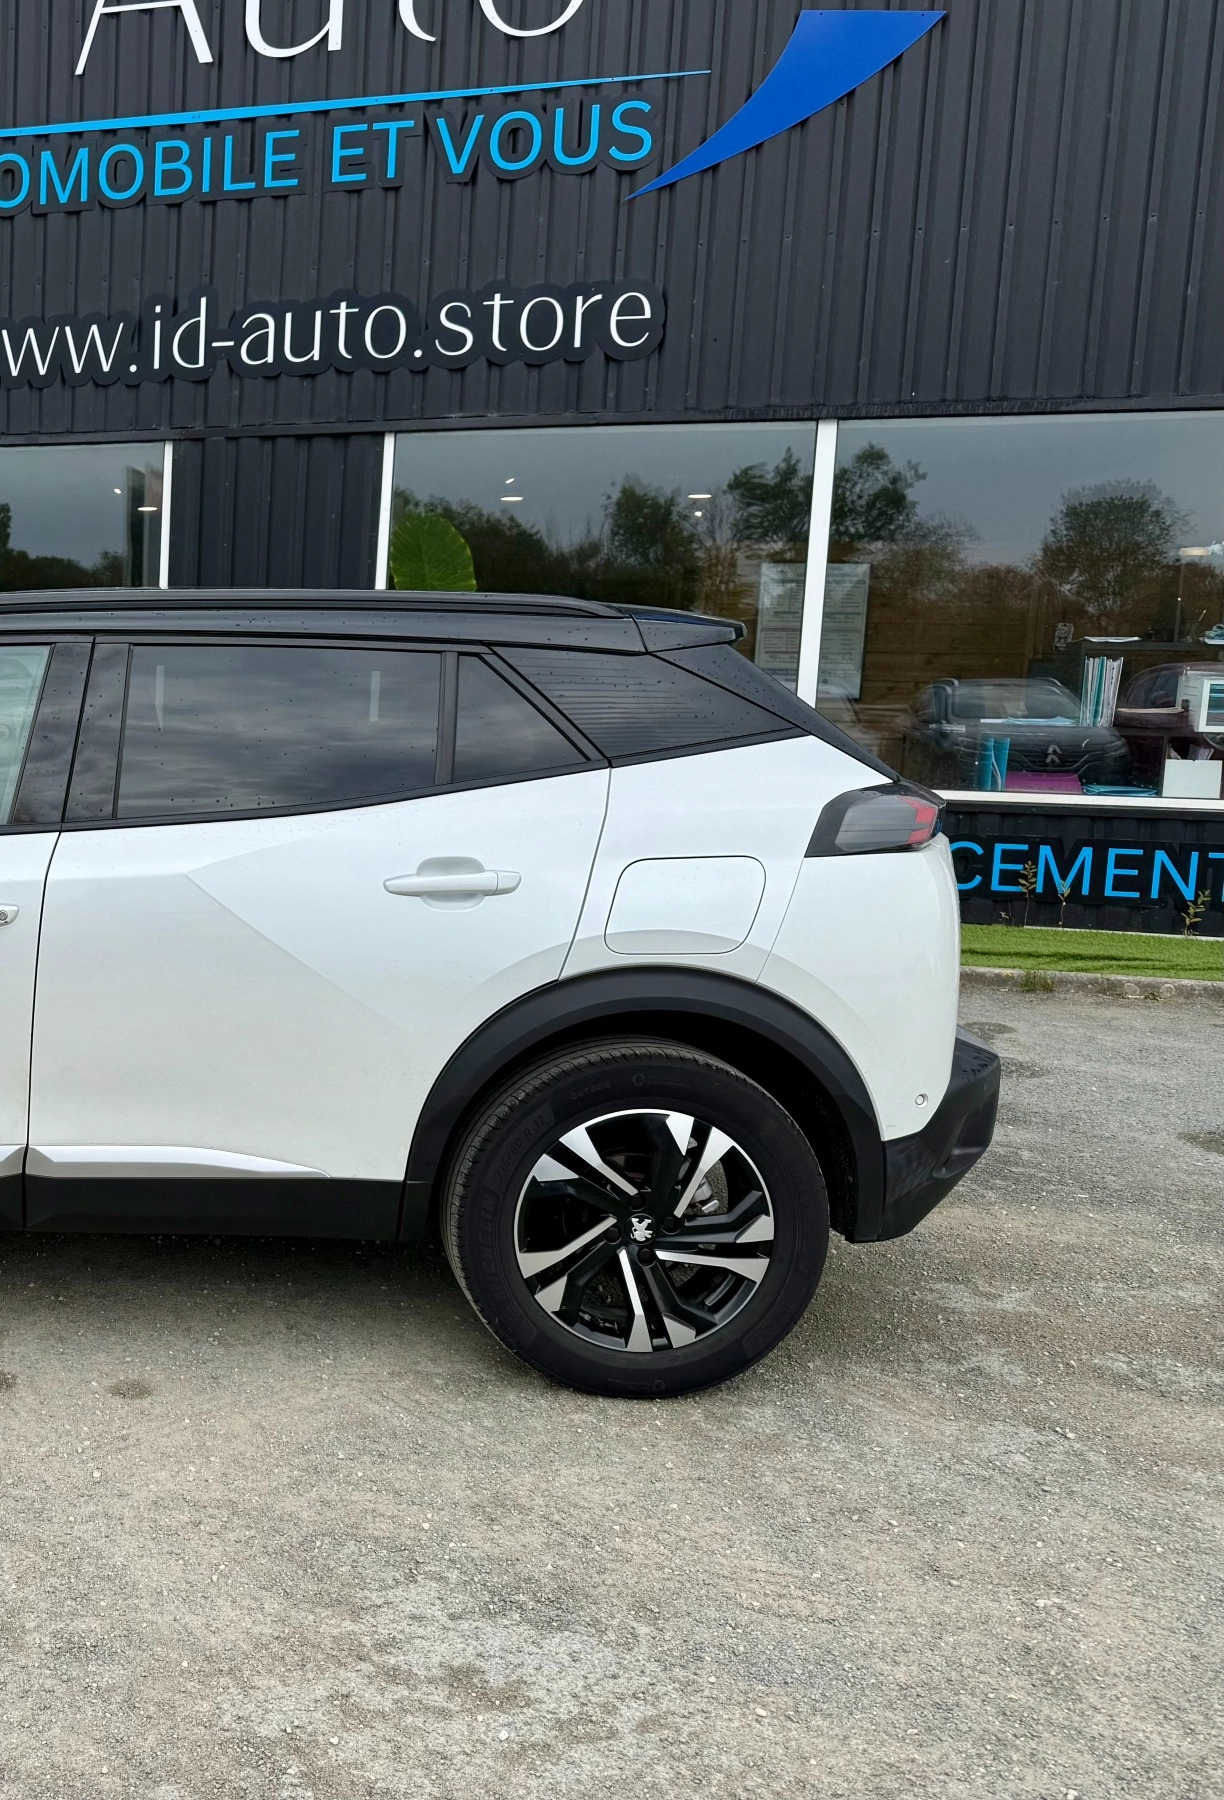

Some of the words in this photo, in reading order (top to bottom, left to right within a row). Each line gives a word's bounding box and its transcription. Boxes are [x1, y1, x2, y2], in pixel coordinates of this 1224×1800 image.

[332, 120, 414, 182] ET
[437, 101, 652, 174] VOUS
[523, 1127, 533, 1140] R
[533, 1114, 545, 1129] 17
